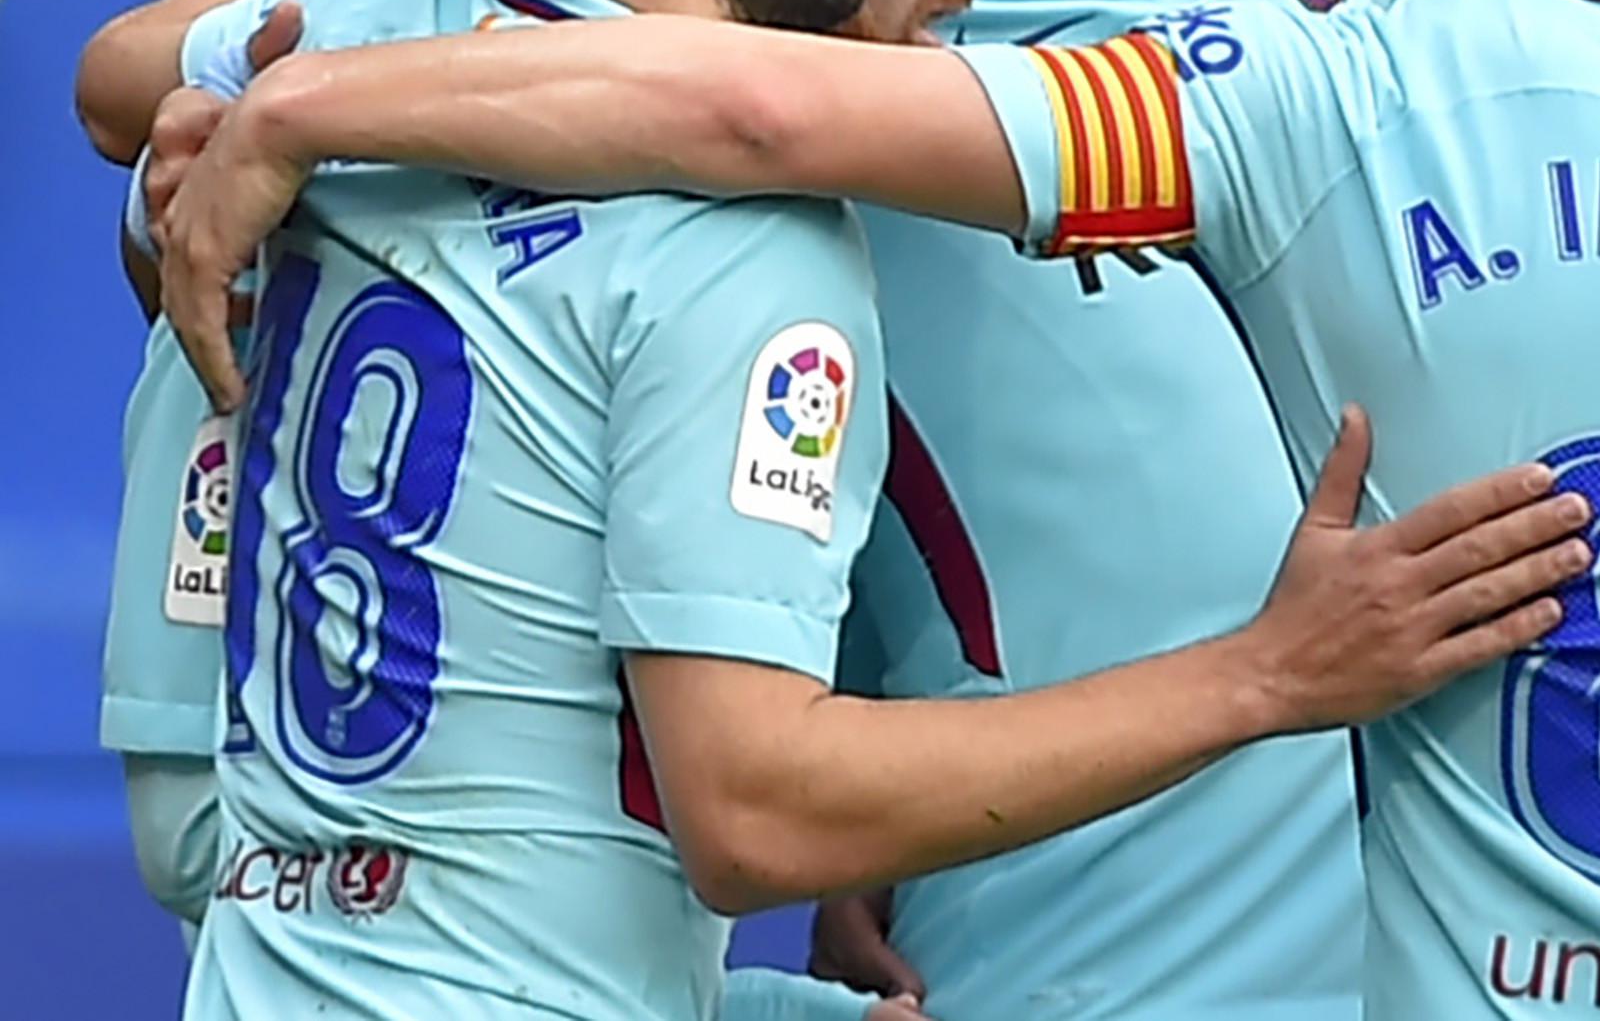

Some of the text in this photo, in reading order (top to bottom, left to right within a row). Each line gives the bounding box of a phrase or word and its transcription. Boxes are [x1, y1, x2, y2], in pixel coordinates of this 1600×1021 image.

[1403, 195, 1522, 308] A.
[222, 252, 472, 787] 18
[173, 563, 228, 595] LaLi
